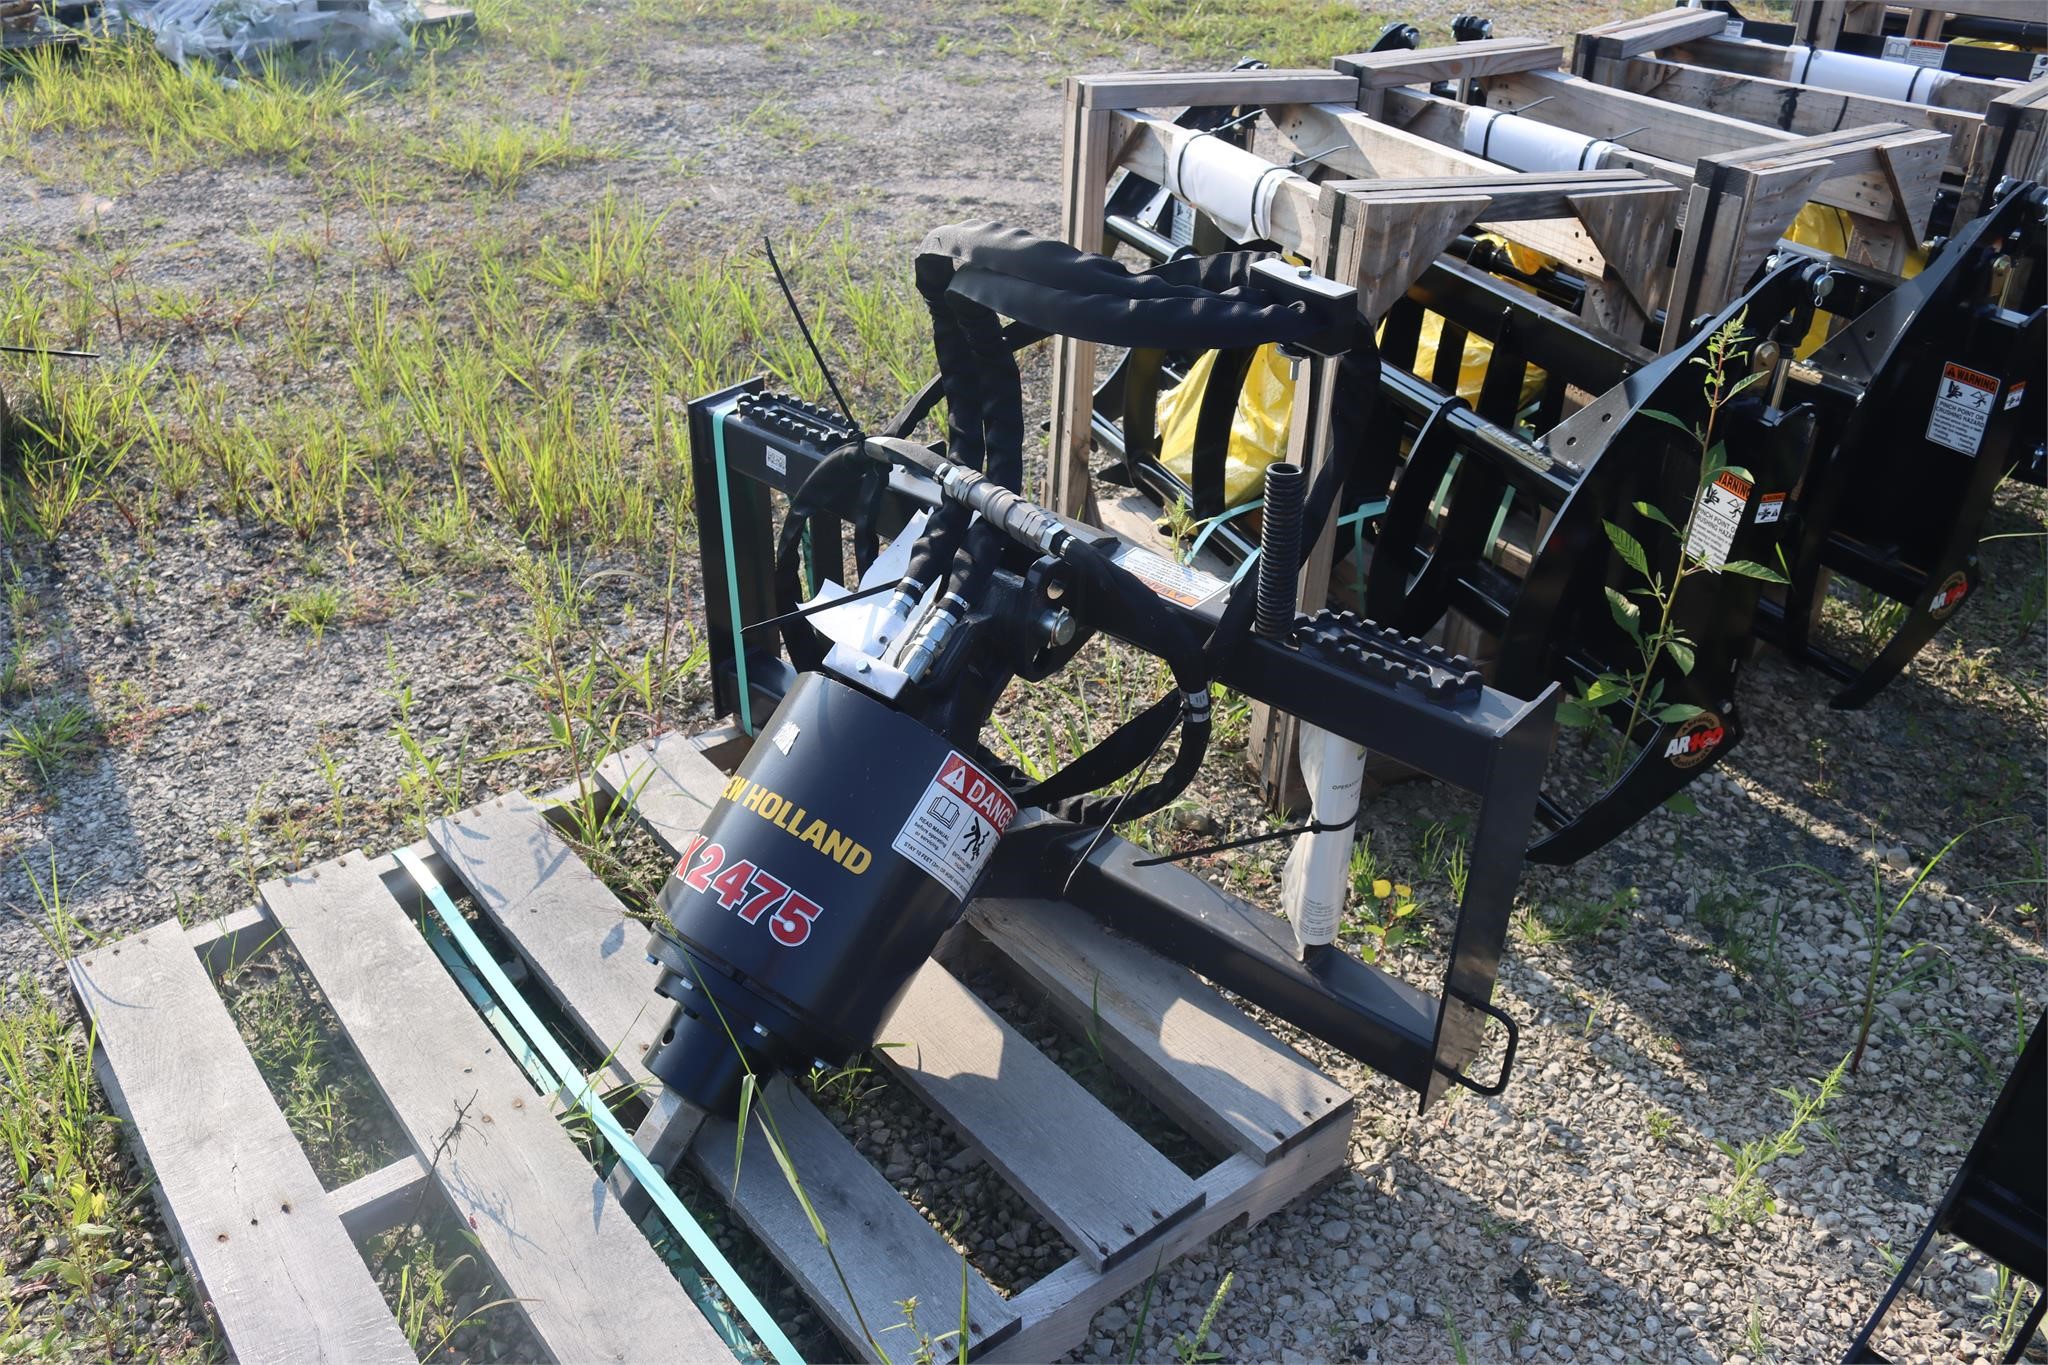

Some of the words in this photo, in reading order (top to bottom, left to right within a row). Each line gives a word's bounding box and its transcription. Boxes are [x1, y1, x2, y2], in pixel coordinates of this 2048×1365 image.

[1957, 369, 1996, 391] WARNING
[1935, 405, 1962, 420] CRUSHING
[1962, 415, 1985, 428] HAZARD
[1939, 400, 1957, 411] PINCH
[1957, 406, 1975, 417] POINT
[1975, 413, 1985, 421] OR
[1696, 515, 1719, 534] RUSHING
[1699, 509, 1715, 521] INCH
[1714, 515, 1731, 529] POINT
[967, 779, 1014, 832] DANGE
[722, 775, 751, 801] EW
[742, 784, 872, 875] HOLLAND
[914, 822, 929, 834] before
[928, 832, 947, 848] operating
[919, 816, 933, 828] READ
[932, 825, 950, 841] MANUAL
[904, 841, 916, 852] STAY
[921, 852, 932, 864] FEET
